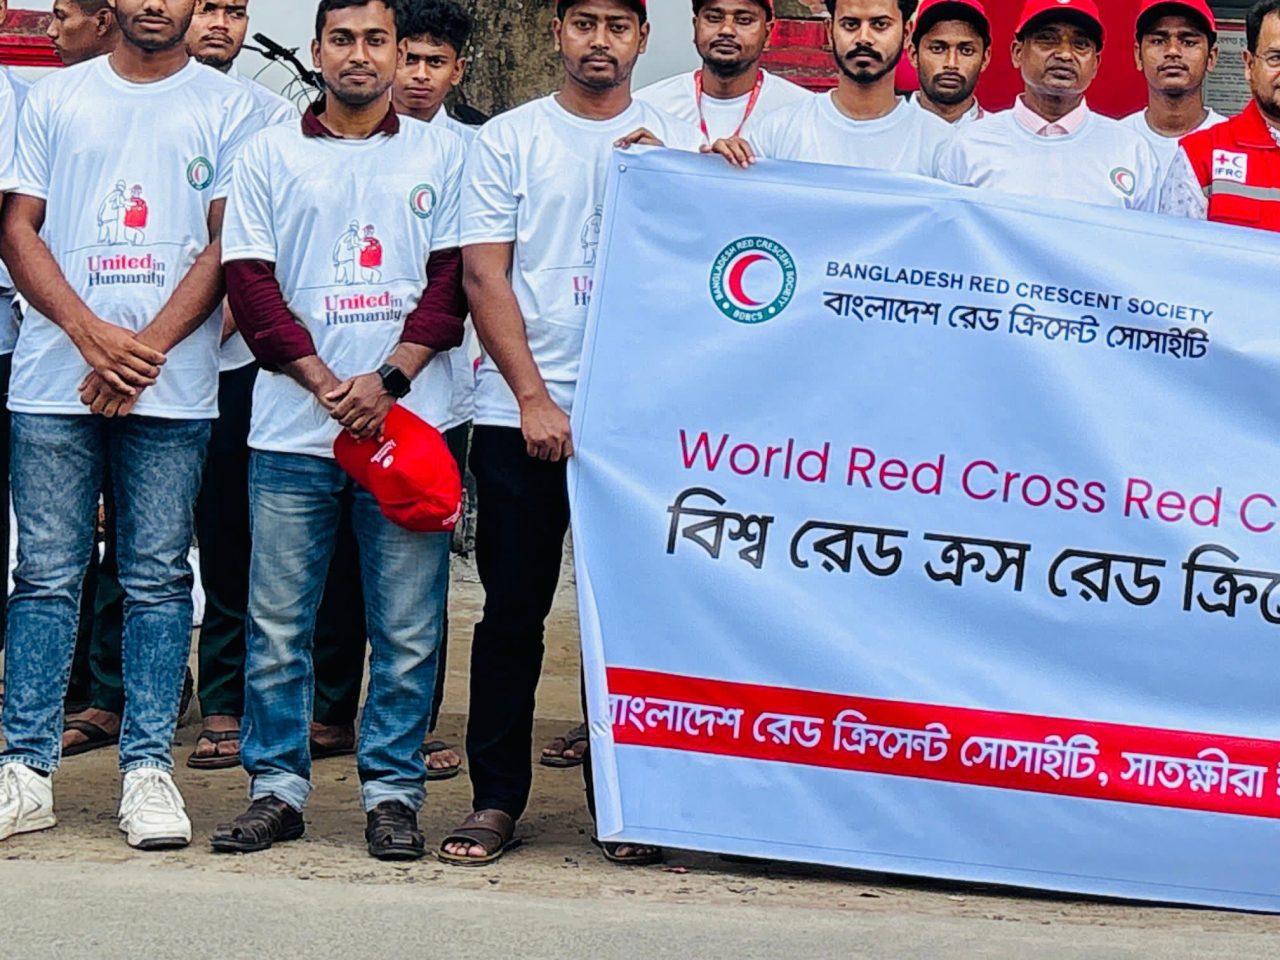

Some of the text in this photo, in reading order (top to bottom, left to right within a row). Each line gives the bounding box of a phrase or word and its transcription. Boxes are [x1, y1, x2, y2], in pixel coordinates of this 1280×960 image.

[1215, 168, 1243, 178] IFRC
[88, 253, 152, 272] United
[88, 270, 166, 288] Humanity
[325, 291, 389, 311] United
[825, 261, 1214, 325] BANGLADESH RED CRESCENT SOCIETY
[325, 308, 402, 327] Humanity
[823, 291, 1210, 359] বাংলাদেশ রেড ক্রিসেন্ট সোসাইটি
[678, 428, 830, 484] World
[846, 446, 945, 496] Red
[961, 459, 1107, 513] Cross
[1123, 477, 1222, 527] Red
[666, 487, 774, 569] বিশ্ব
[790, 520, 908, 577] রেড
[924, 532, 1031, 592] ক্রস
[1048, 548, 1167, 606] রেড
[753, 711, 825, 748] রেড
[832, 708, 951, 762] ক্রিসেন্ট
[959, 734, 1108, 787] সোসাইটি,
[1120, 747, 1268, 799] সাতক্ষীরা
